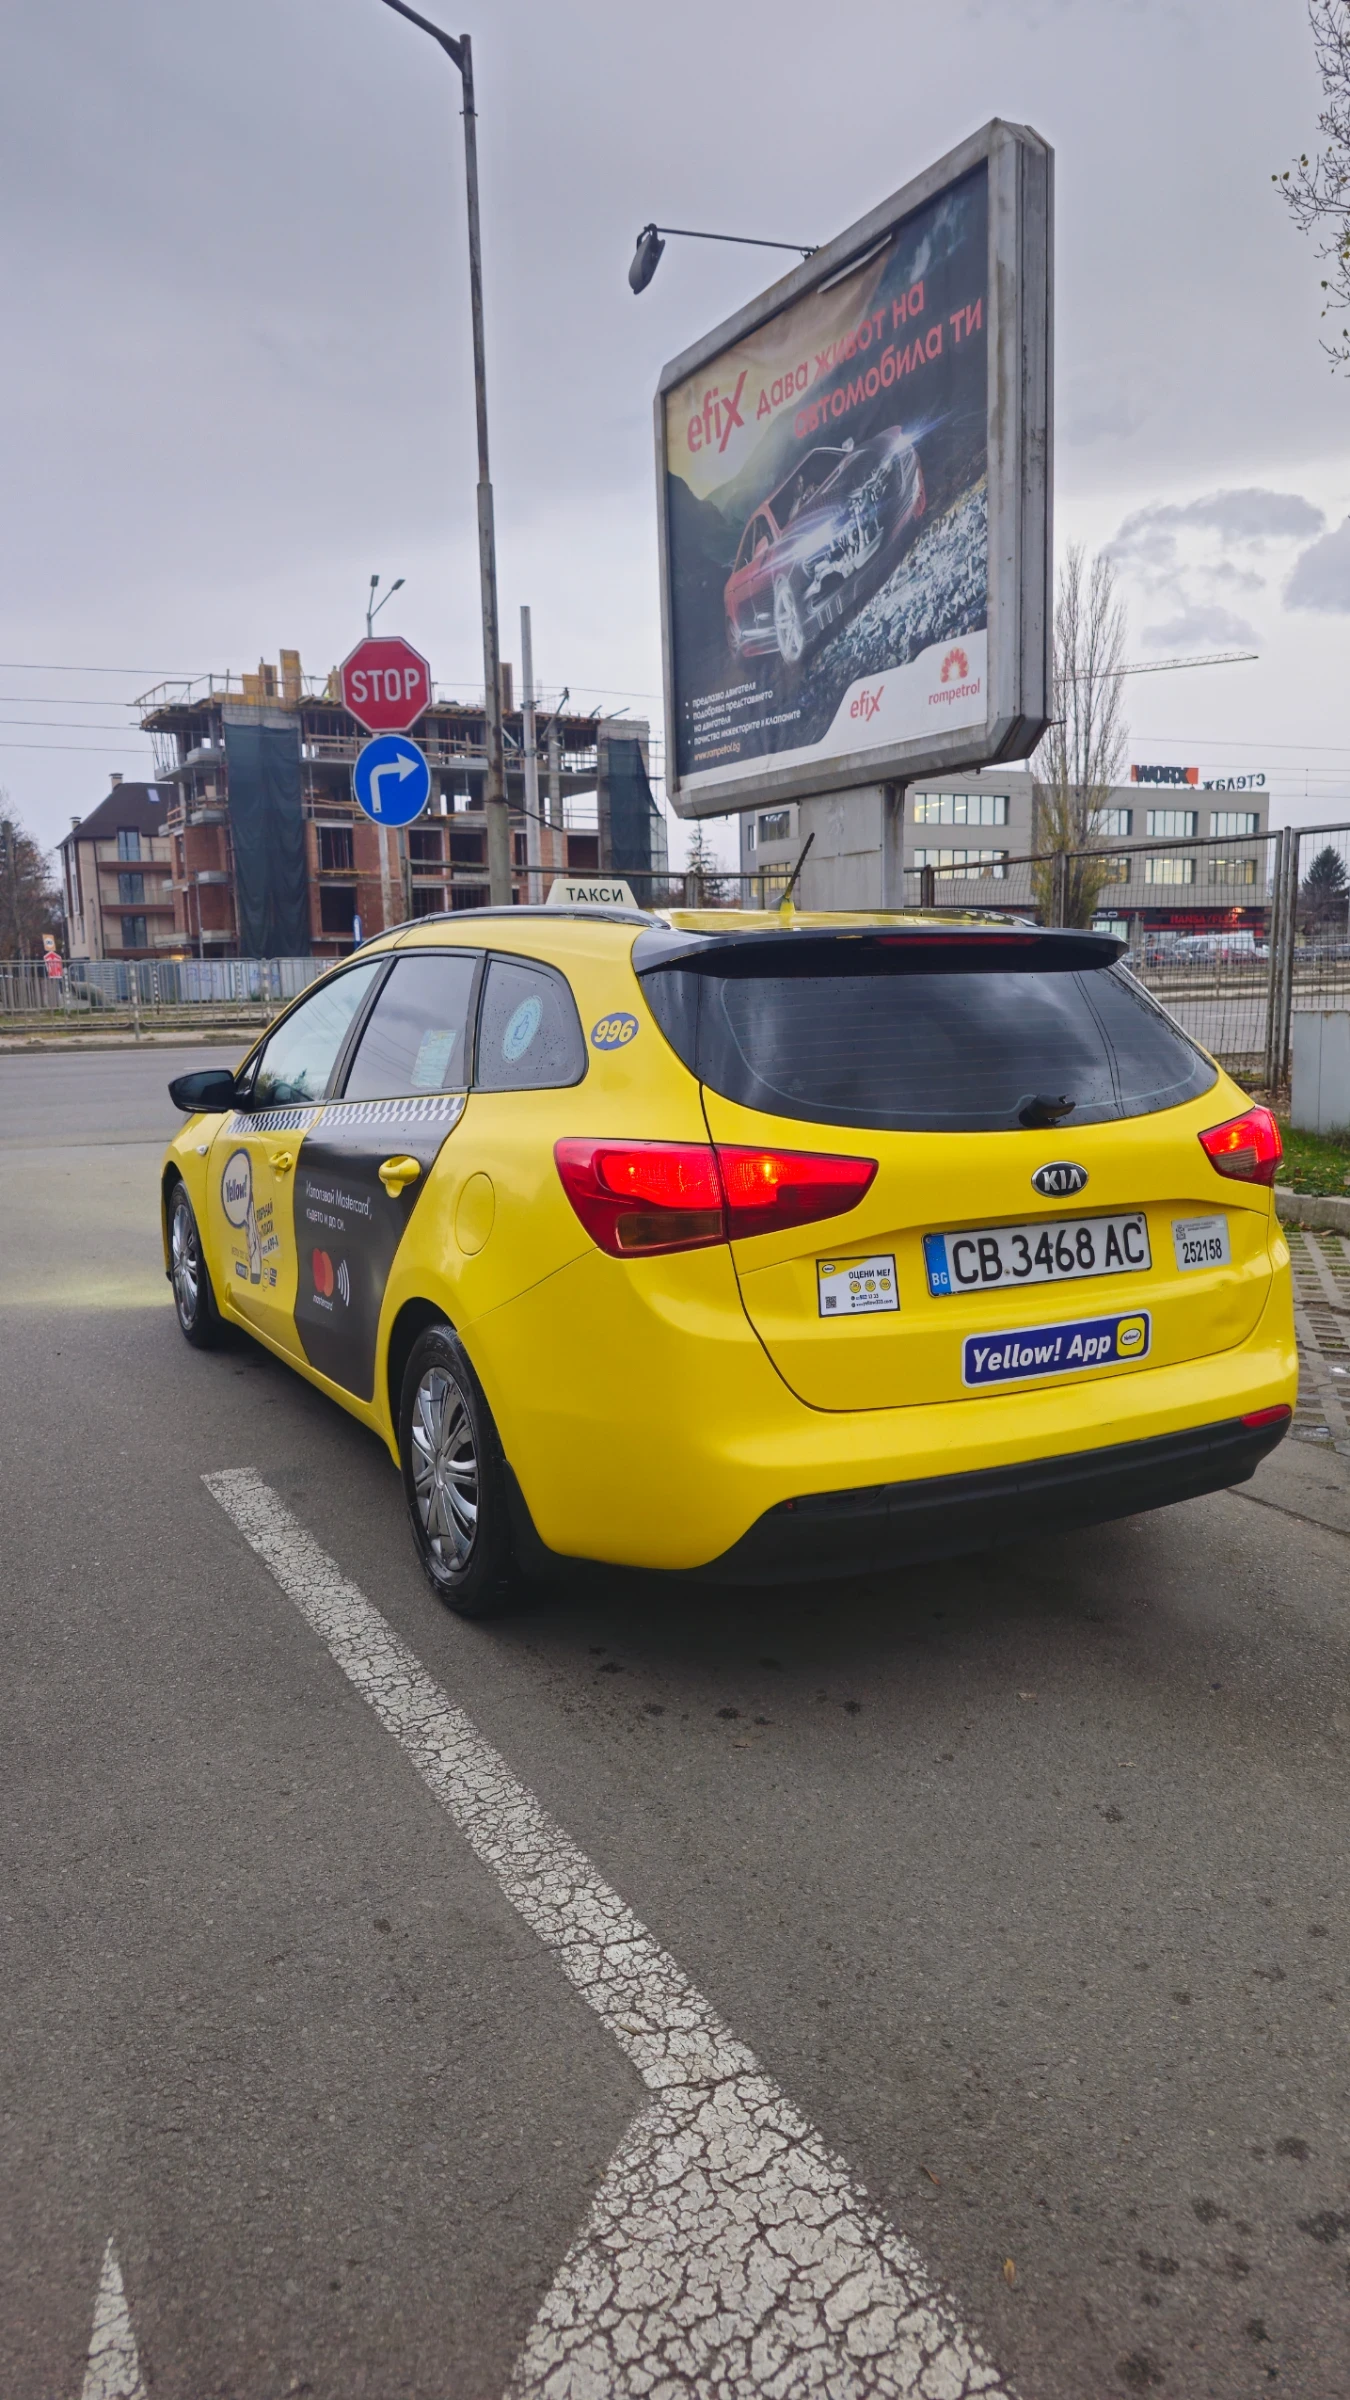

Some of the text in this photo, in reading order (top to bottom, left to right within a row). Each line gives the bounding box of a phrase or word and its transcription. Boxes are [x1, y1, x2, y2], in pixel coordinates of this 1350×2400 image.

[687, 280, 924, 453] efix дава живот на
[794, 297, 982, 439] автомобила ти
[351, 668, 420, 703] STOP
[725, 682, 756, 699] двигателя
[928, 677, 981, 705] rompetrol
[850, 685, 884, 722] efix
[702, 716, 731, 732] двигателя
[765, 709, 801, 726] клапаните
[1134, 765, 1191, 784] WORX
[566, 887, 624, 902] ТАКСИ
[594, 1020, 636, 1043] 996
[1043, 1169, 1082, 1191] KIA
[932, 1222, 1145, 1286] BG CB 3468 AC
[1182, 1237, 1222, 1264] 252158
[848, 1268, 891, 1280] ОЦЕНИ МЕ!
[973, 1334, 1111, 1373] Yellow! App
